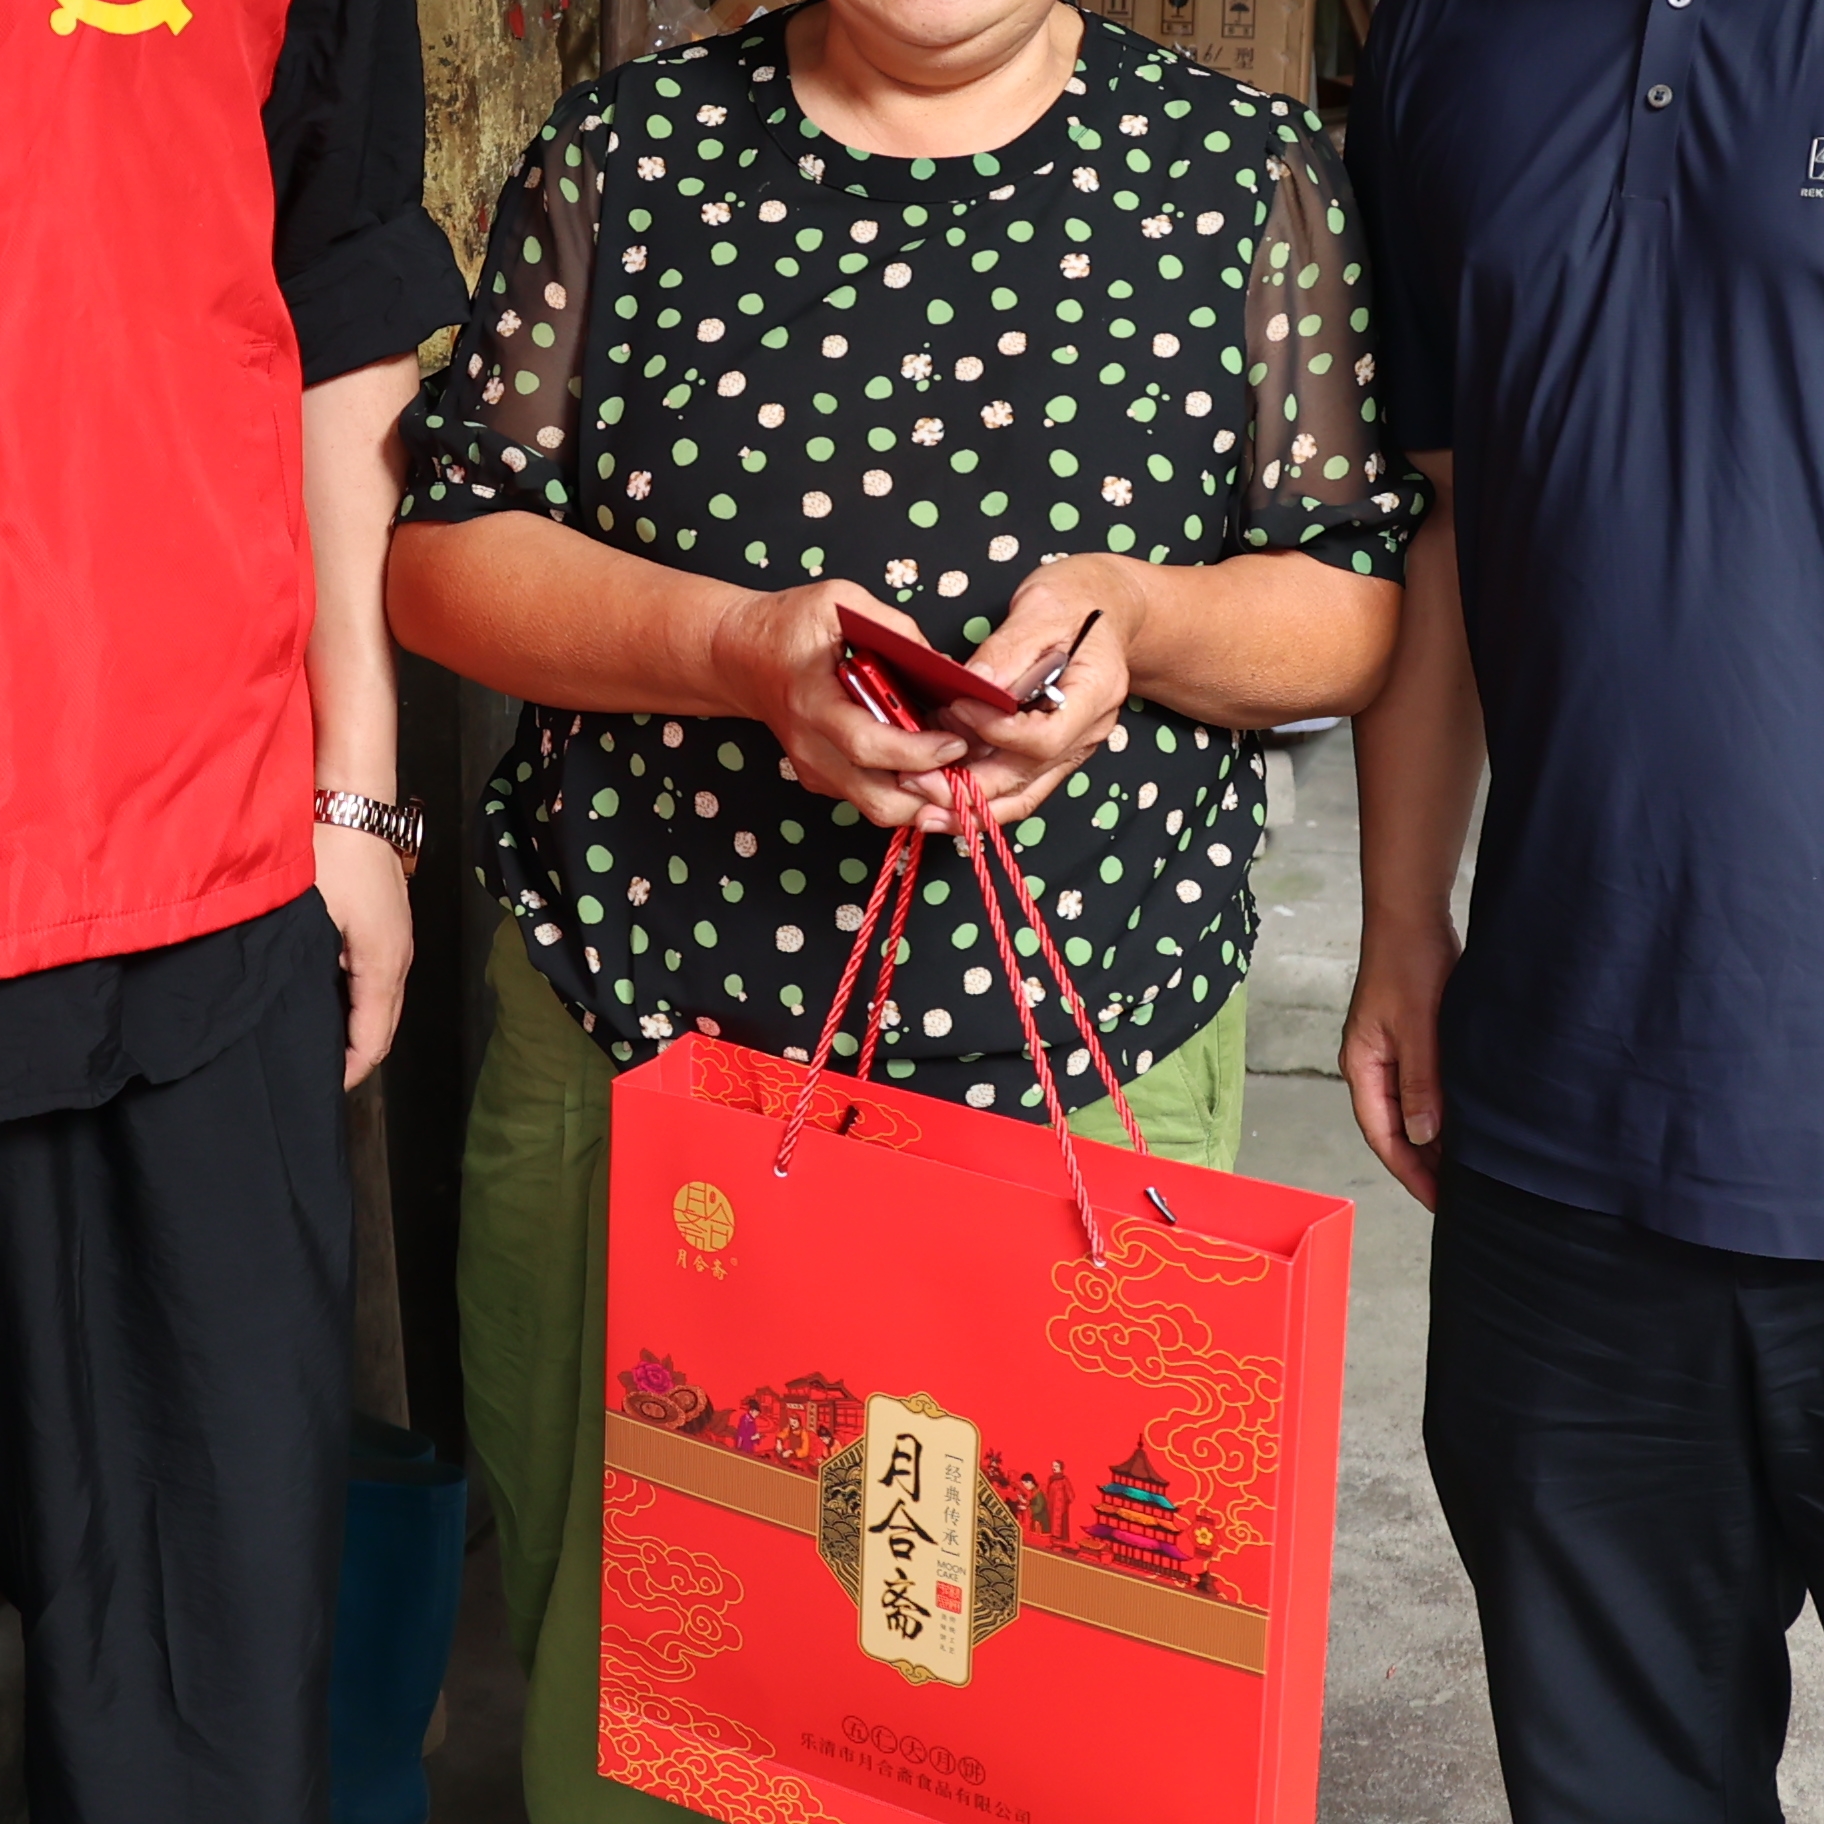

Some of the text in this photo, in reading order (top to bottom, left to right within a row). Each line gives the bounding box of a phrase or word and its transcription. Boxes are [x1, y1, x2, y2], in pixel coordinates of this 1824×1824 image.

[868, 1433, 939, 1640] 月合斋
[936, 1569, 958, 1582] CAKE
[937, 1560, 966, 1575] MOON
[801, 1732, 1031, 1824] 乐清市月合斋食品有限公司
